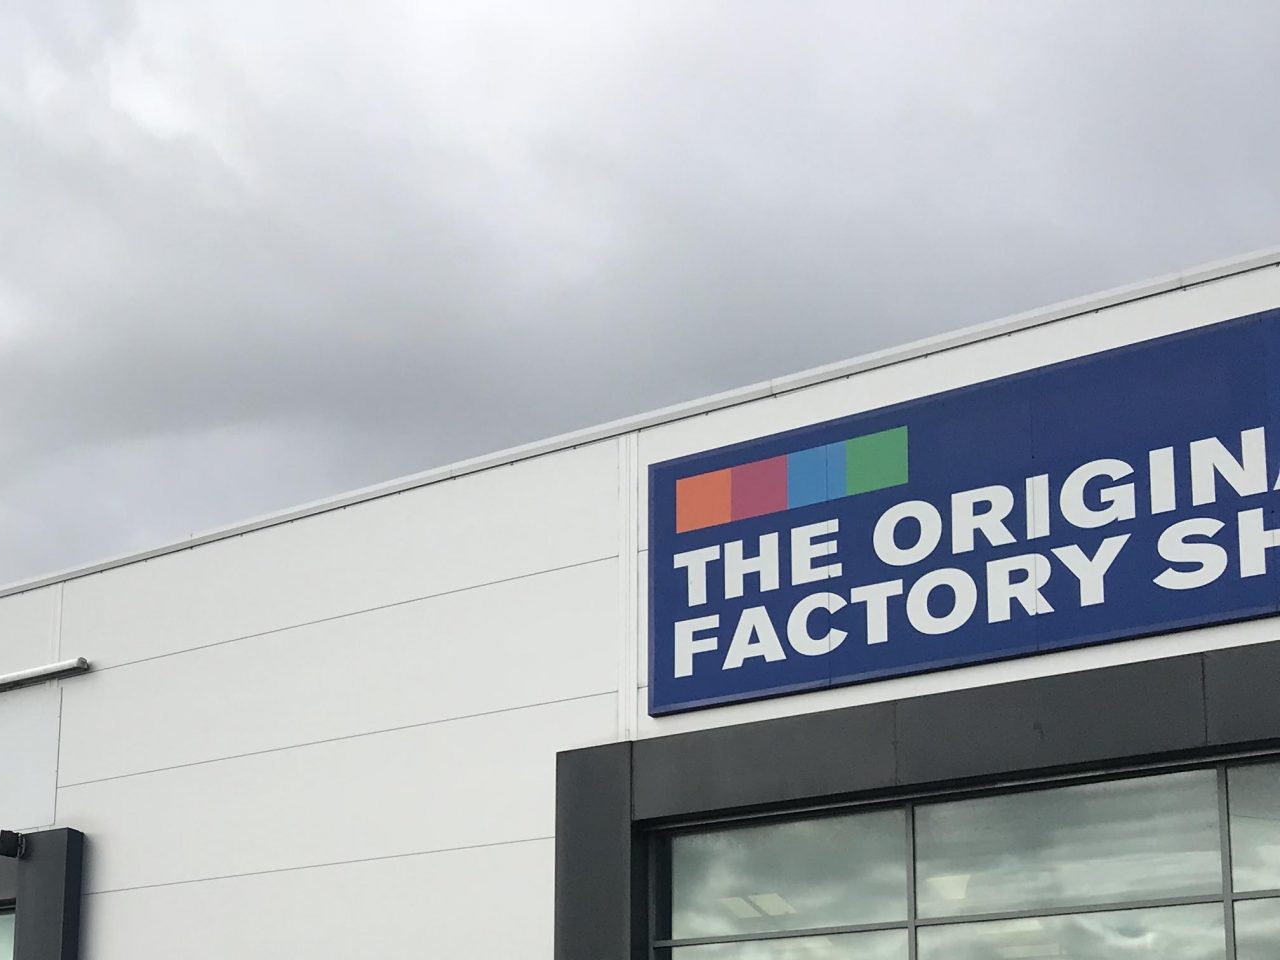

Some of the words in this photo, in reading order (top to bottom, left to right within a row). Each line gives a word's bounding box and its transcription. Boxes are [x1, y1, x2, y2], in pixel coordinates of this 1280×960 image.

[673, 518, 843, 608] THE
[872, 425, 1280, 567] ORIGIN
[674, 533, 1131, 679] FACTORY
